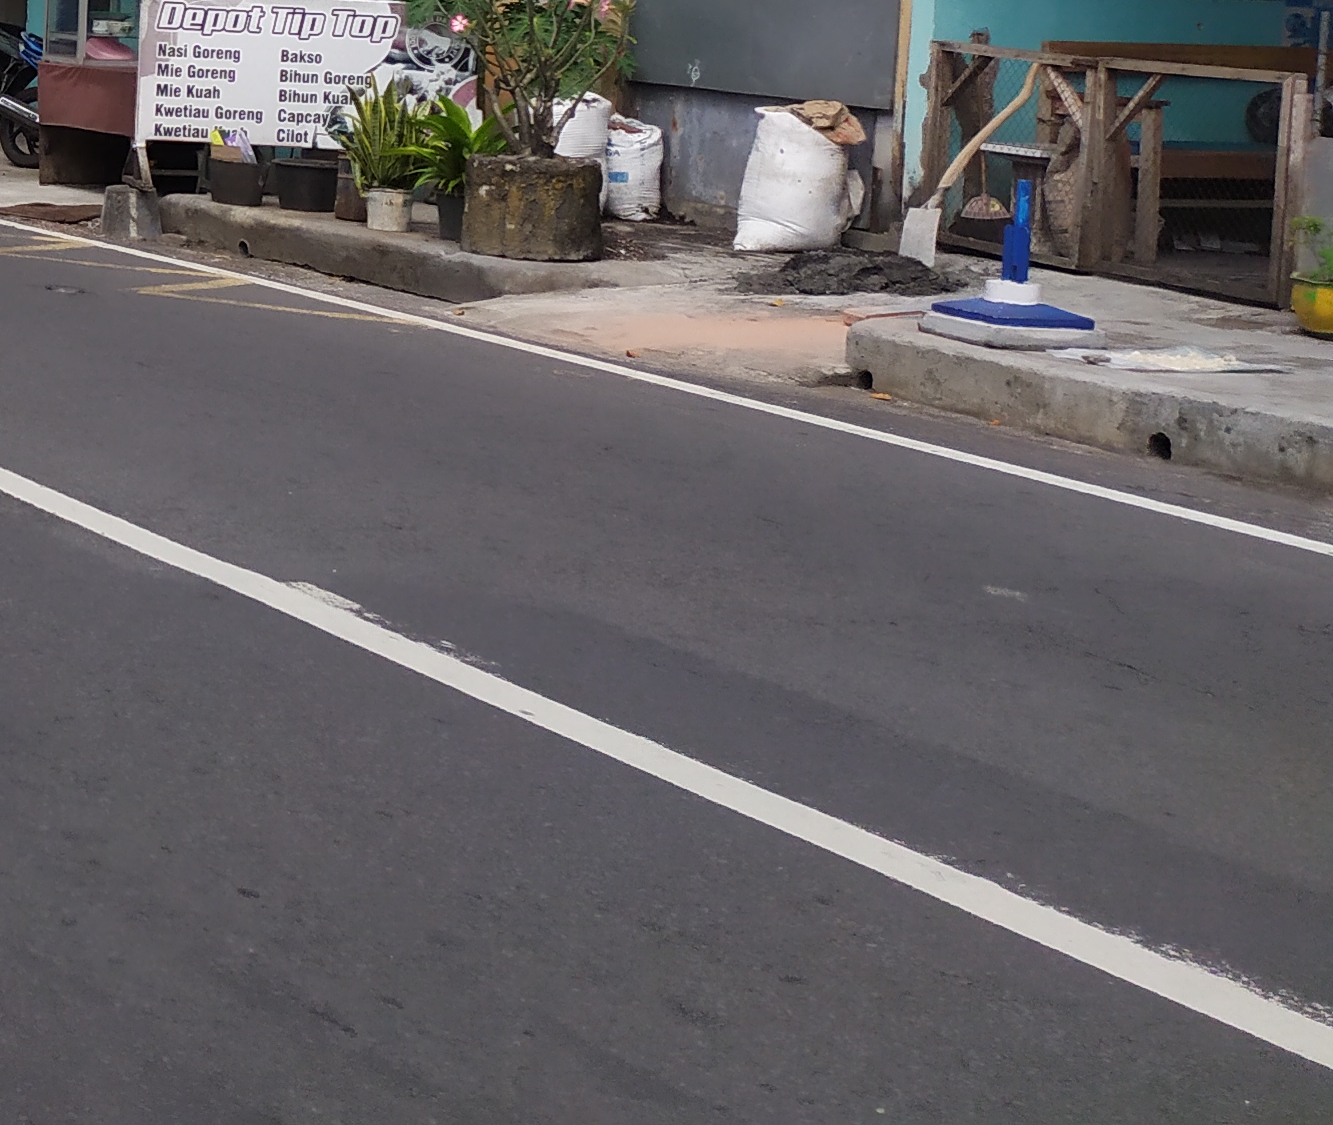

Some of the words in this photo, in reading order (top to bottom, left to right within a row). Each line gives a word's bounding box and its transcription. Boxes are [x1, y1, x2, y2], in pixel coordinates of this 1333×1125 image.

[156, 1, 264, 36] Depot
[271, 6, 326, 40] Tip
[332, 9, 401, 43] Top
[157, 43, 188, 58] Nasi
[192, 44, 241, 63] Goreng
[280, 50, 323, 65] Bakso
[157, 63, 183, 78] Mie
[187, 65, 236, 82] Goreng
[279, 69, 320, 84] Bihun
[323, 72, 372, 89] Goreng
[155, 83, 182, 98] Mie
[186, 85, 221, 99] Kuah
[278, 89, 318, 104] Bihun
[154, 103, 210, 119] Kwetiau
[214, 105, 263, 123] Goreng
[277, 109, 329, 127] Capcay
[153, 123, 209, 138] Kwetiau
[276, 128, 309, 143] Cilot
